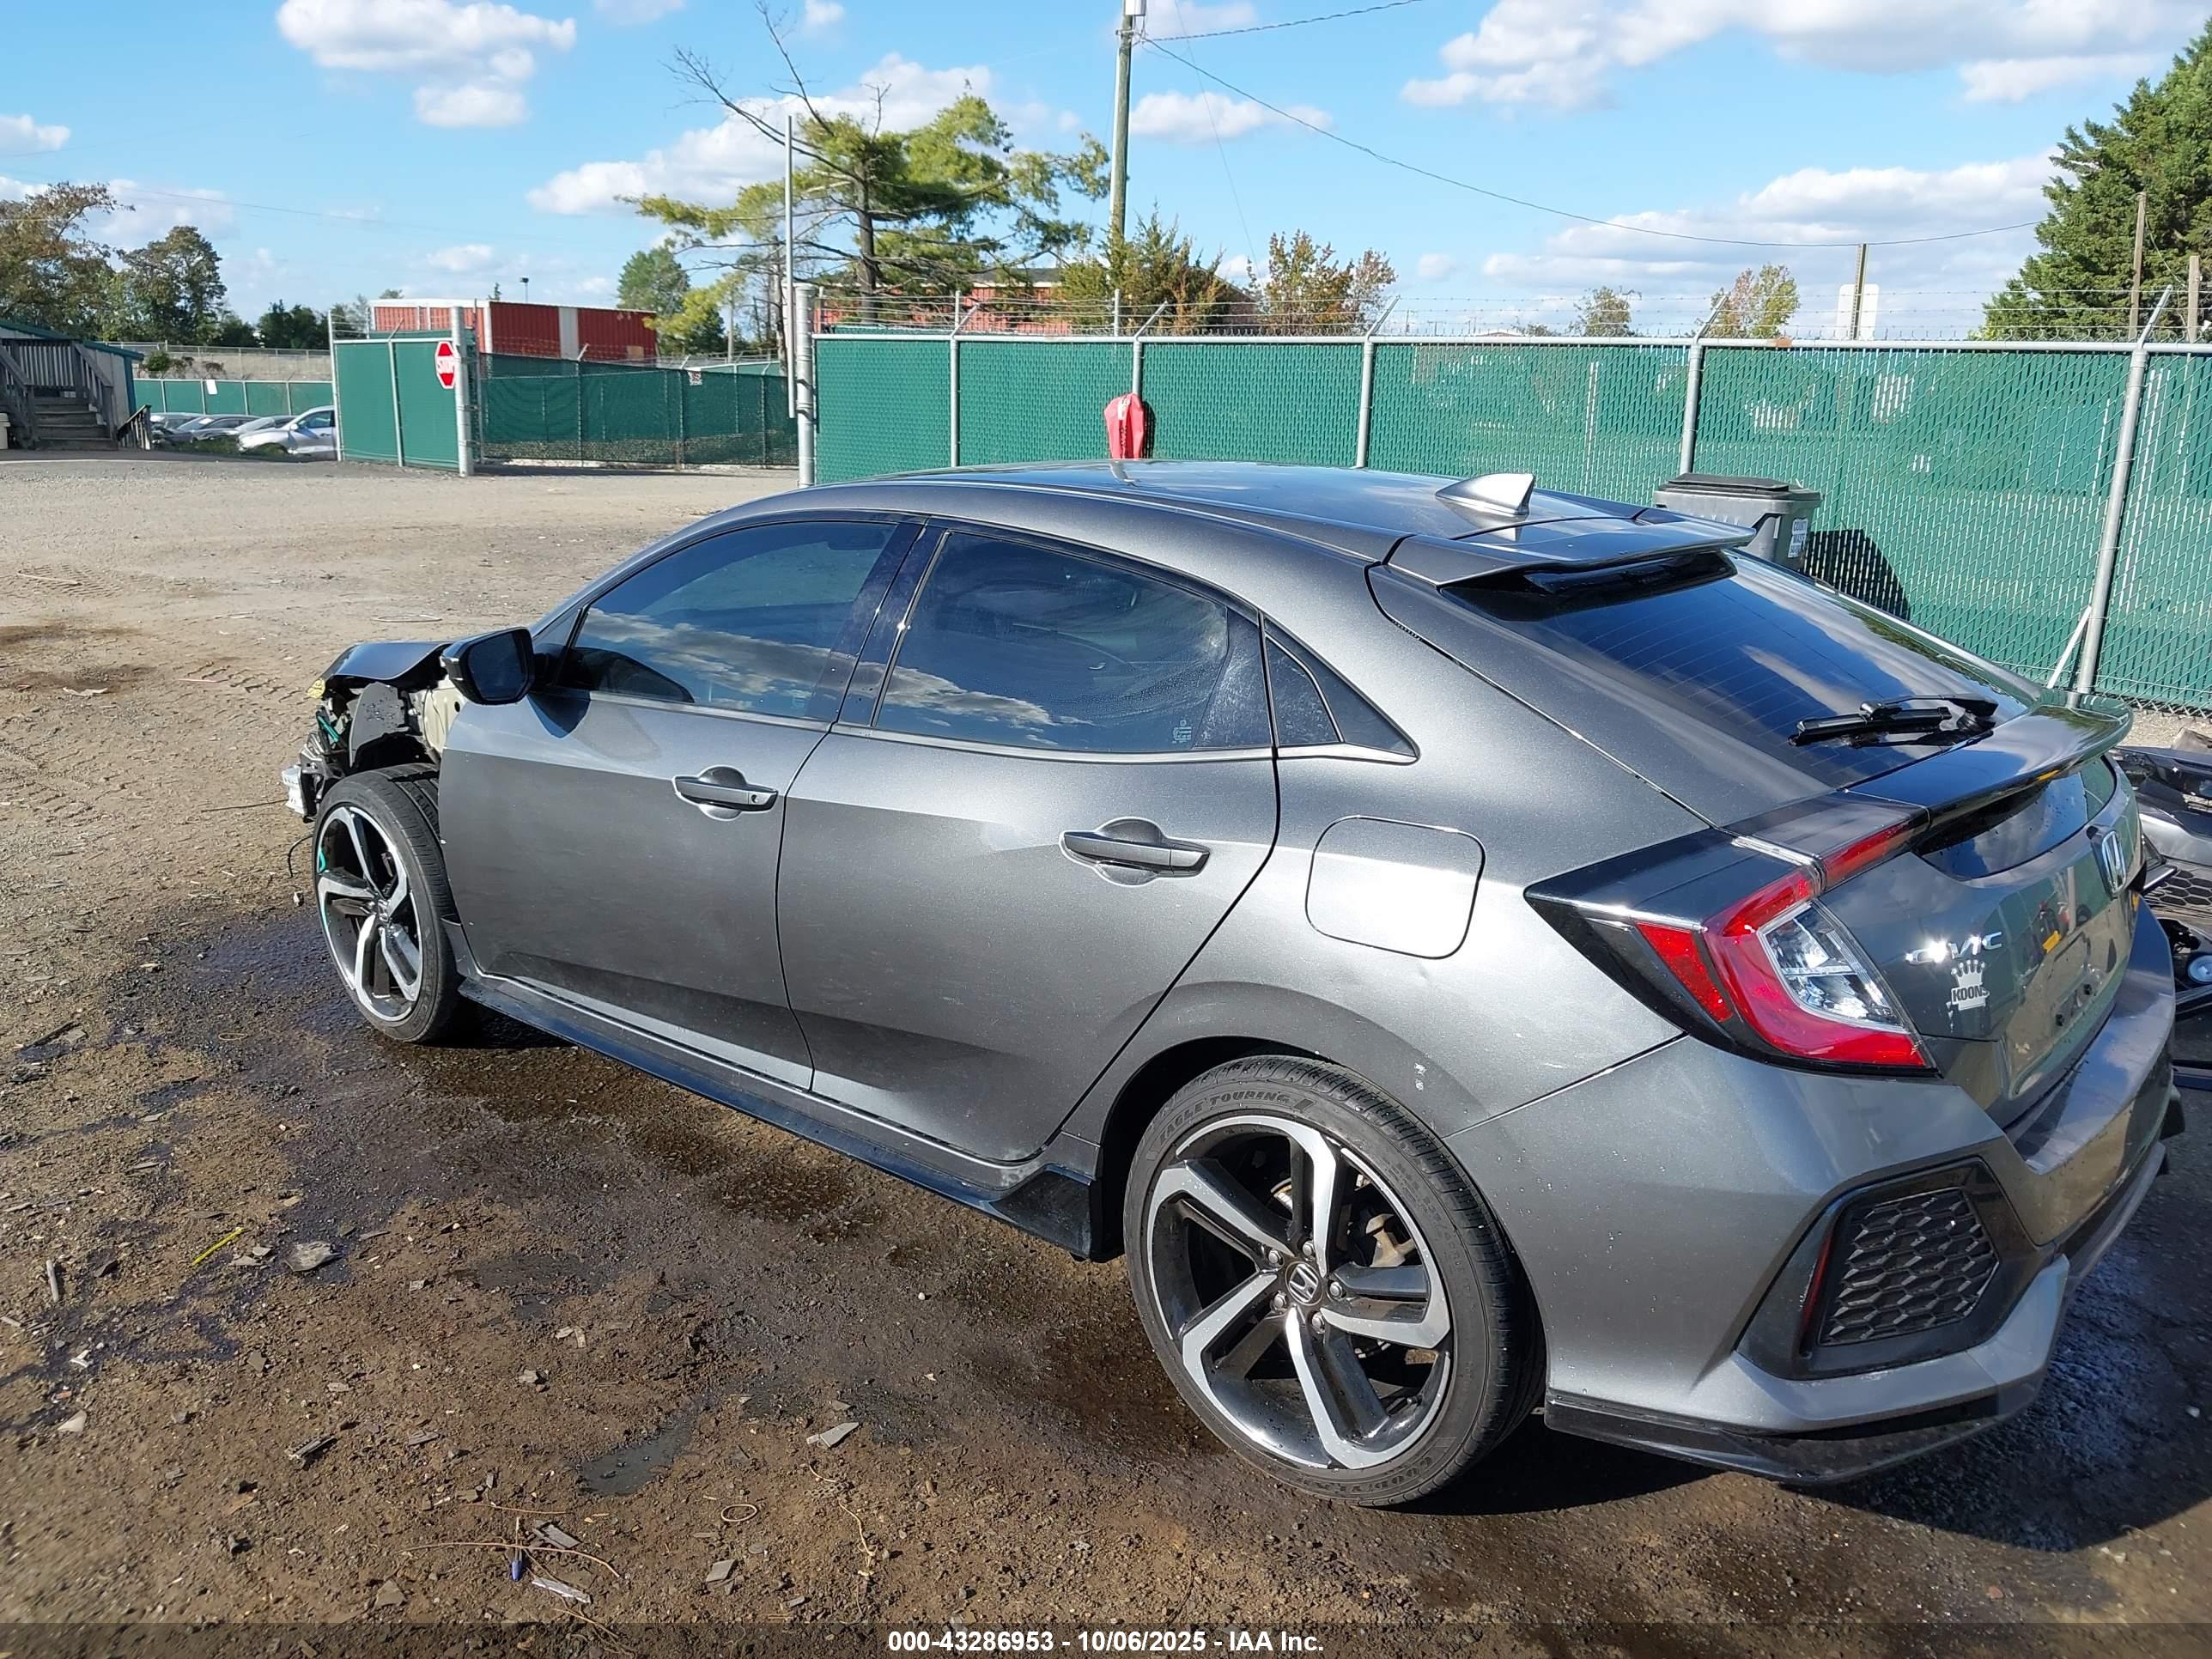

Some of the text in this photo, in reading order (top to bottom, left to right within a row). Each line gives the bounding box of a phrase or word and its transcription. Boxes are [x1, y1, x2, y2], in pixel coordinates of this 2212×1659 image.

[1905, 932, 2002, 965] CVIC
[1953, 986, 1990, 1004] KOONS
[1159, 1091, 1289, 1146] EAGLE TOURING
